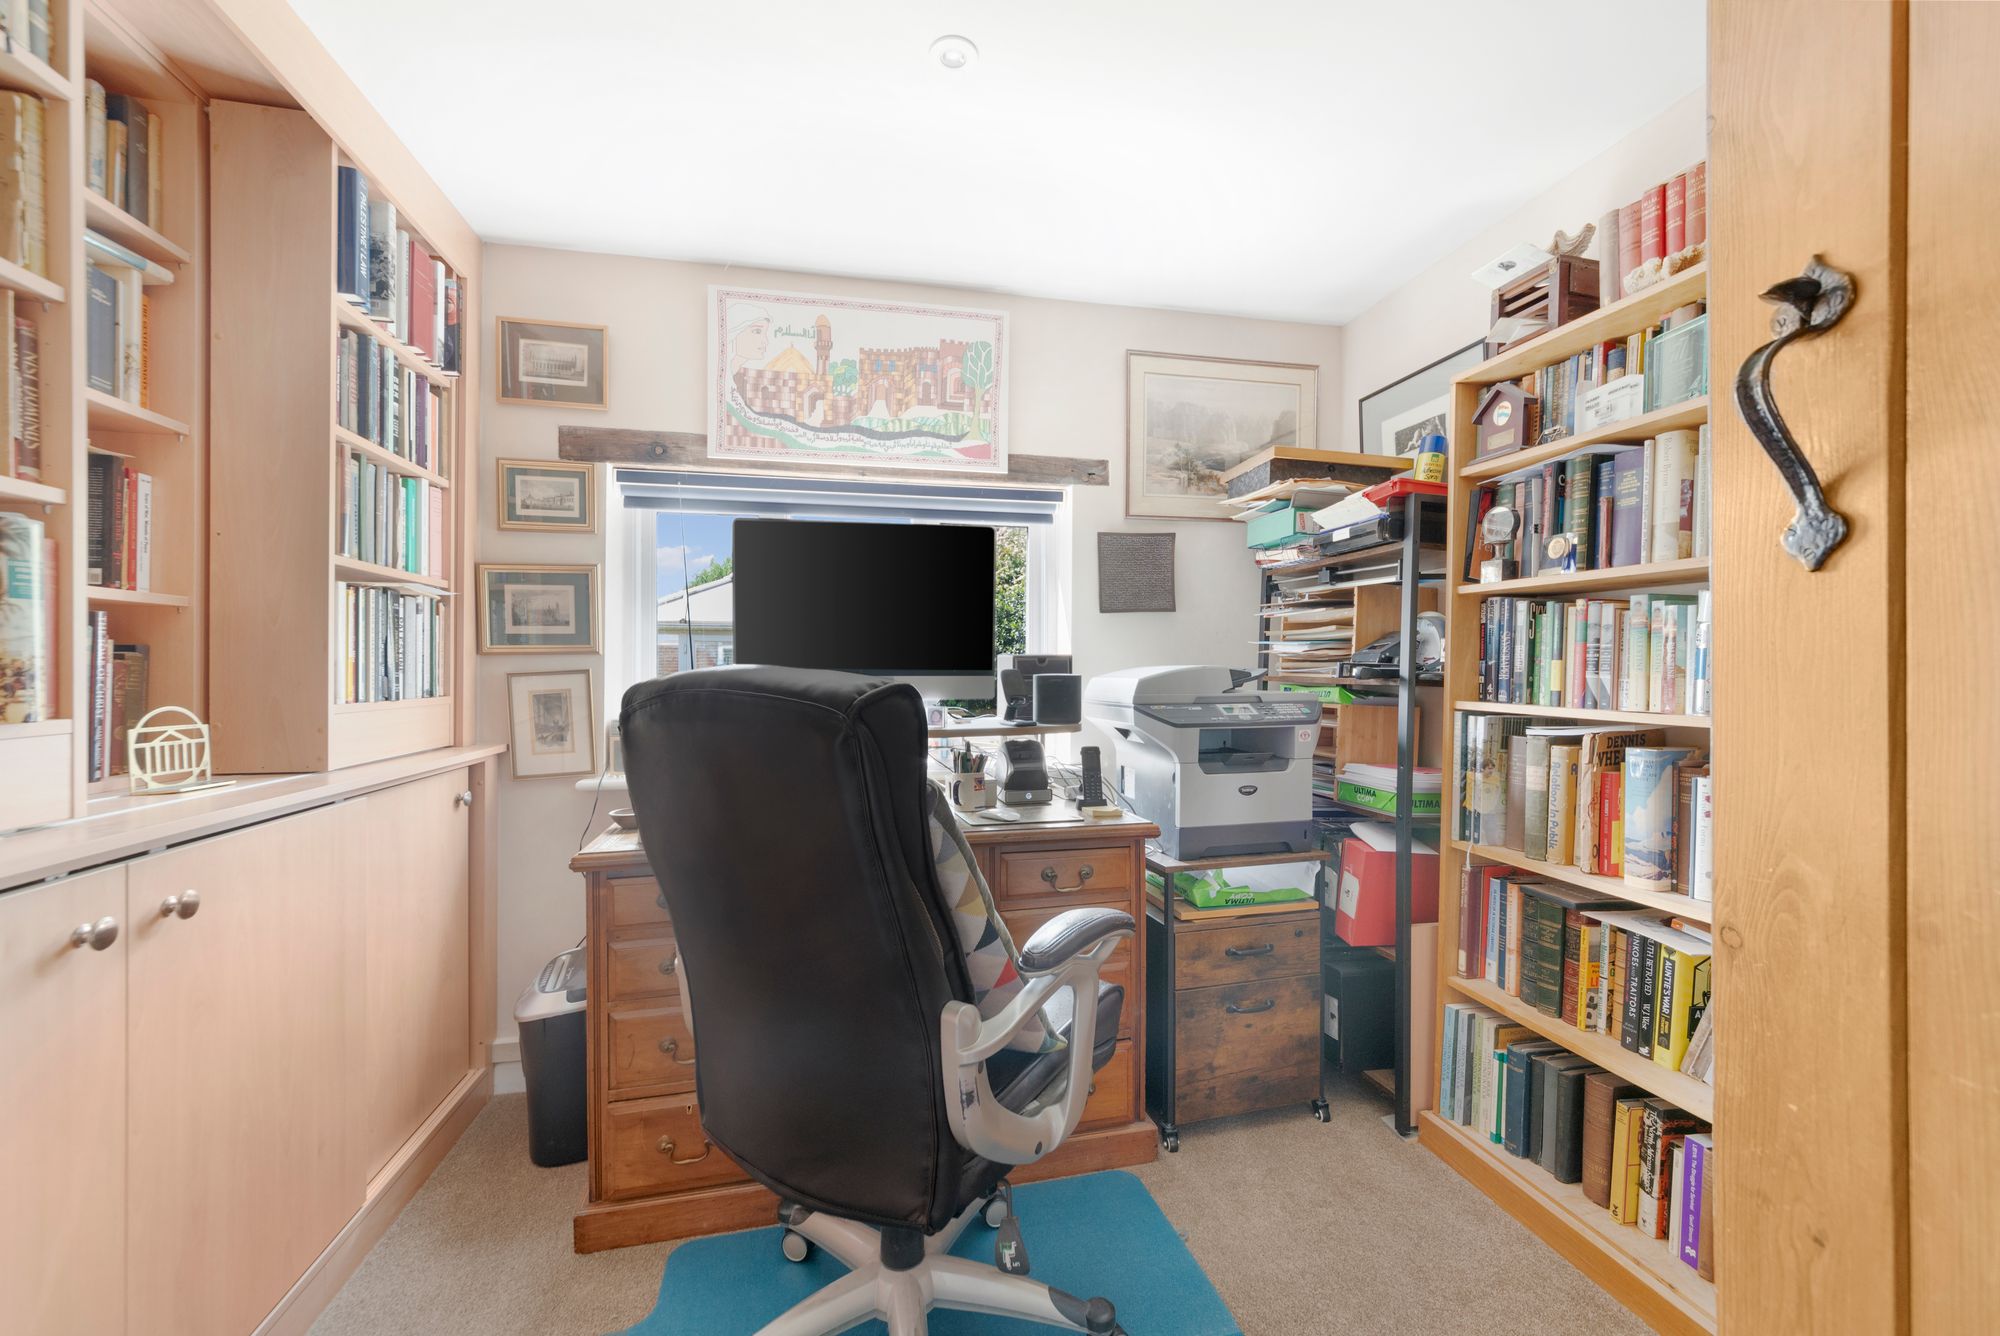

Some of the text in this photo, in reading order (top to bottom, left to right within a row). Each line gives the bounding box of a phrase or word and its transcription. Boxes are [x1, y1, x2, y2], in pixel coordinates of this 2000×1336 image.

[23, 350, 40, 449] NISI DOMINUS
[1606, 734, 1646, 749] DENNIS
[1354, 786, 1376, 797] ULTIMA
[1356, 795, 1374, 803] COPY
[1549, 820, 1559, 849] Public
[1644, 958, 1654, 996] BETRAYED
[1662, 960, 1673, 1014] AUNTIE'S WAR
[1628, 977, 1638, 1017] TRAITORS
